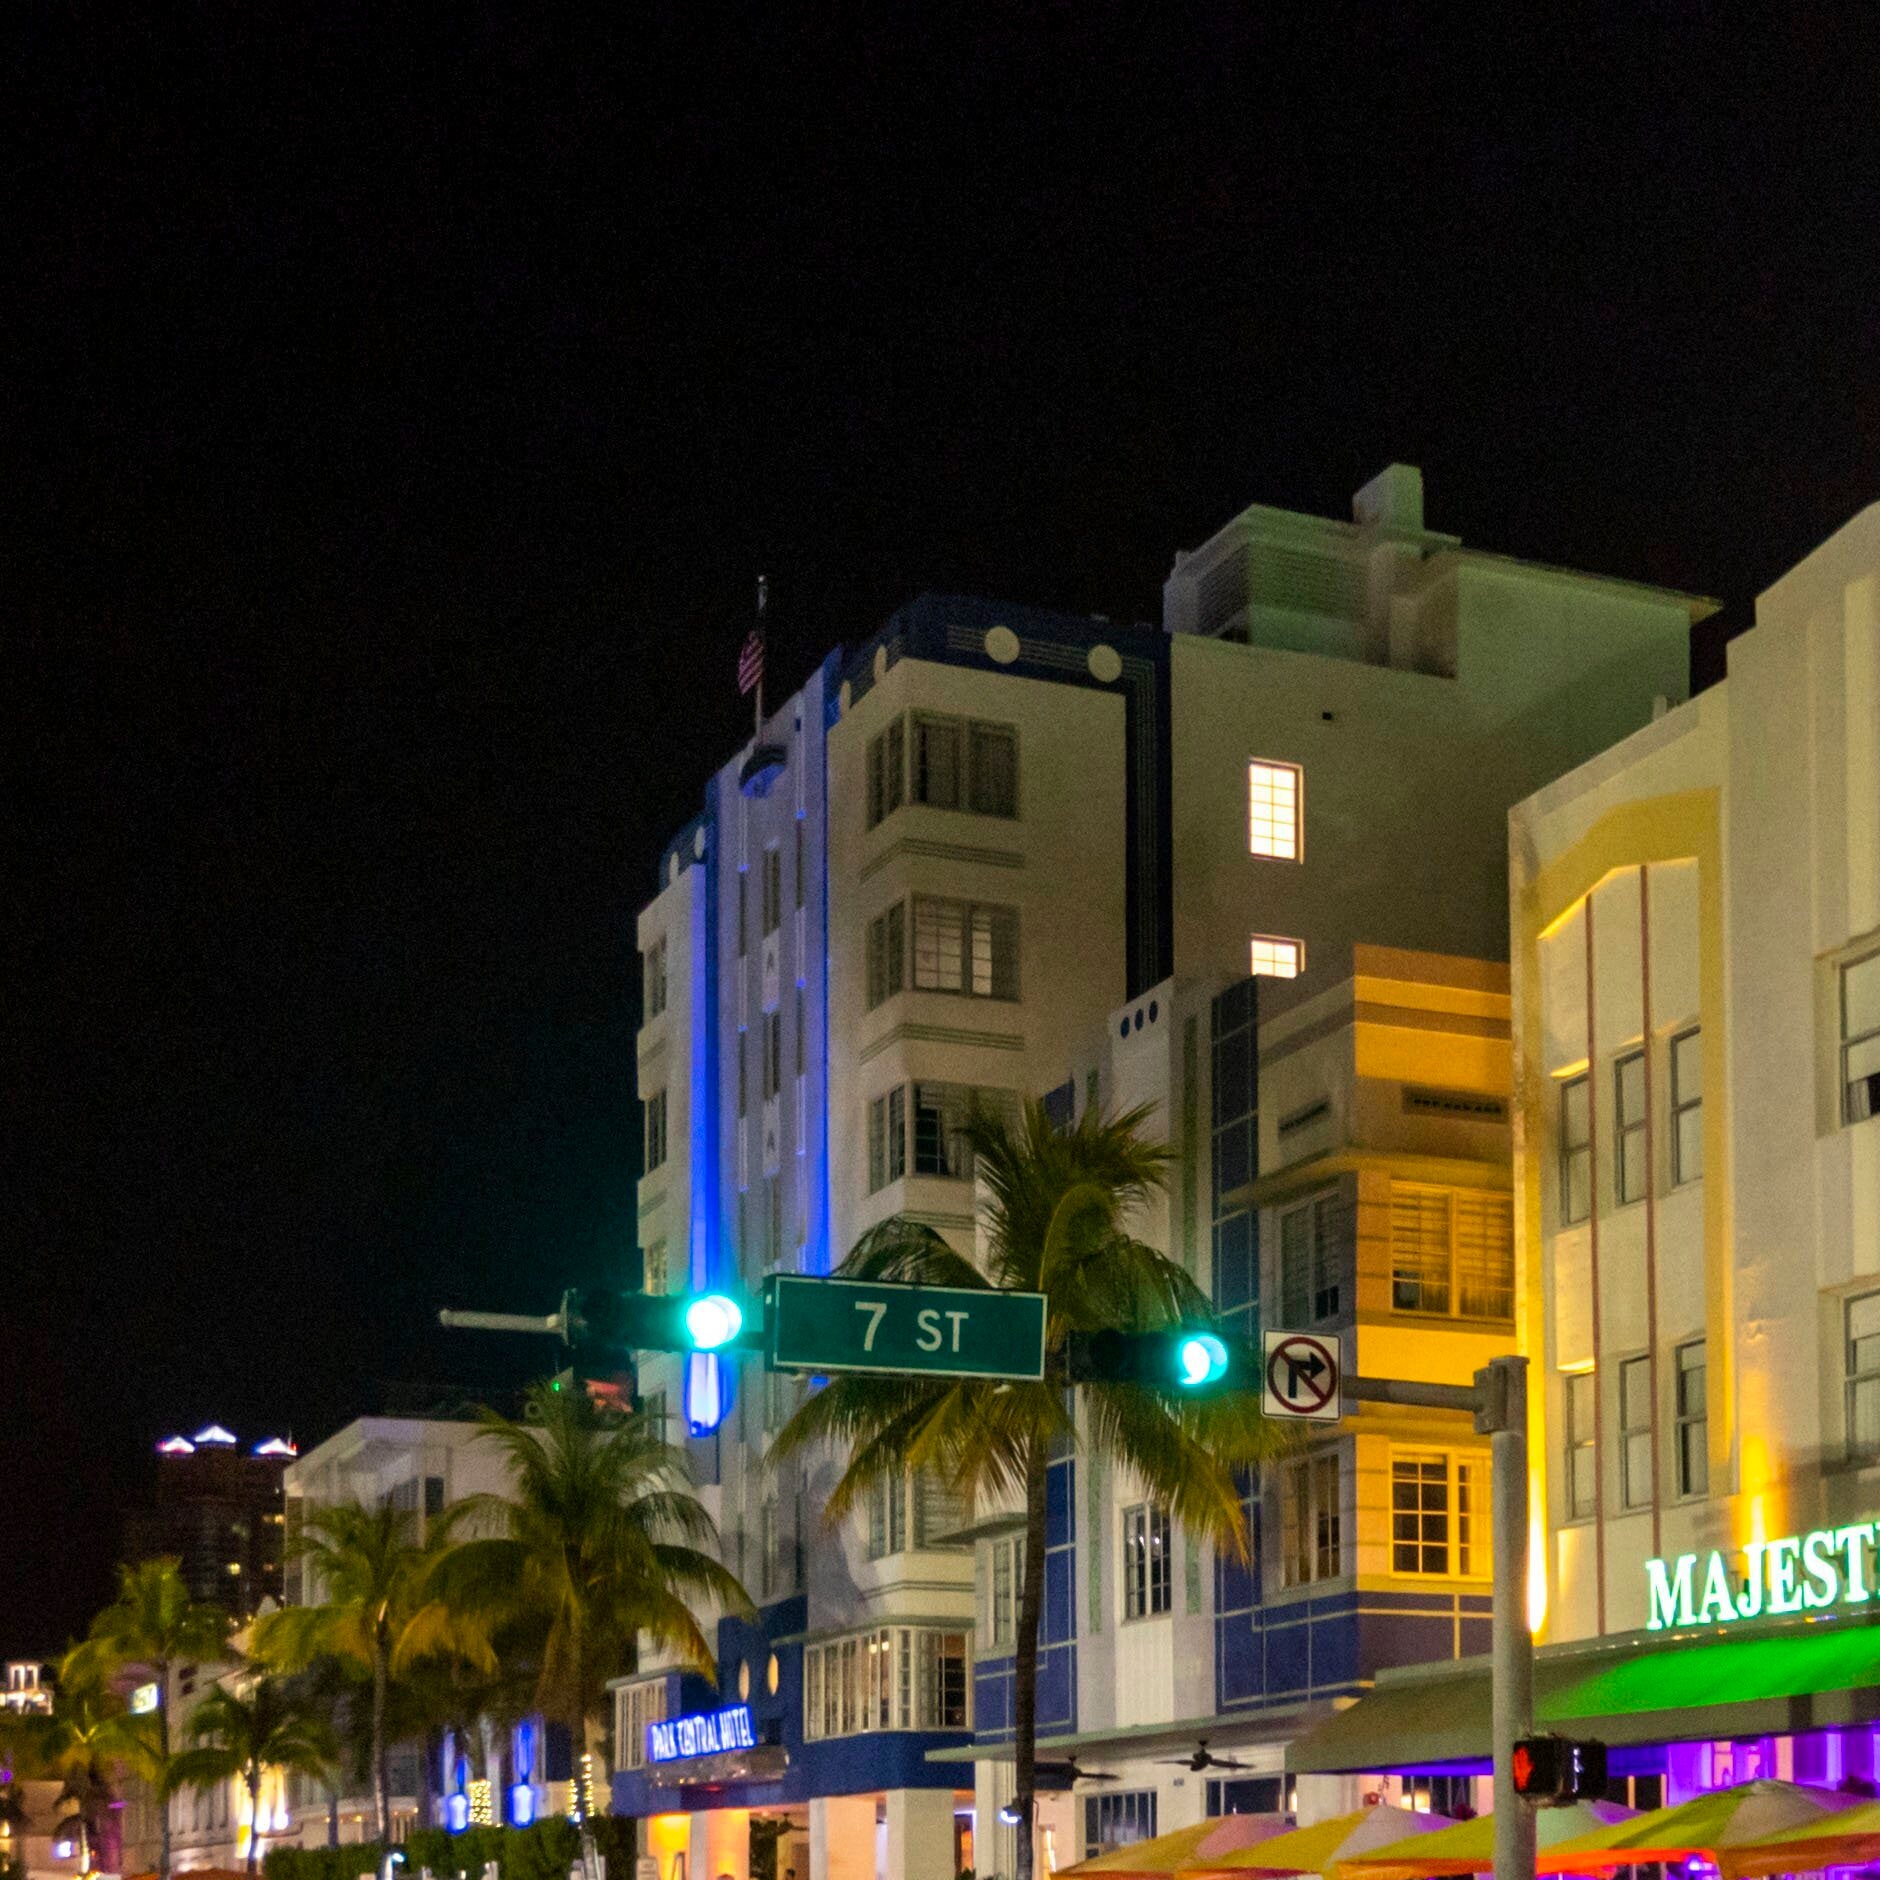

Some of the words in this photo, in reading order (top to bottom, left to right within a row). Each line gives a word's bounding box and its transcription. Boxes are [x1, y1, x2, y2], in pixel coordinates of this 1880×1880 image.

[855, 1301, 887, 1352] 7
[916, 1309, 969, 1352] ST
[651, 1721, 678, 1761] PARK
[719, 1705, 755, 1750] HOTEL
